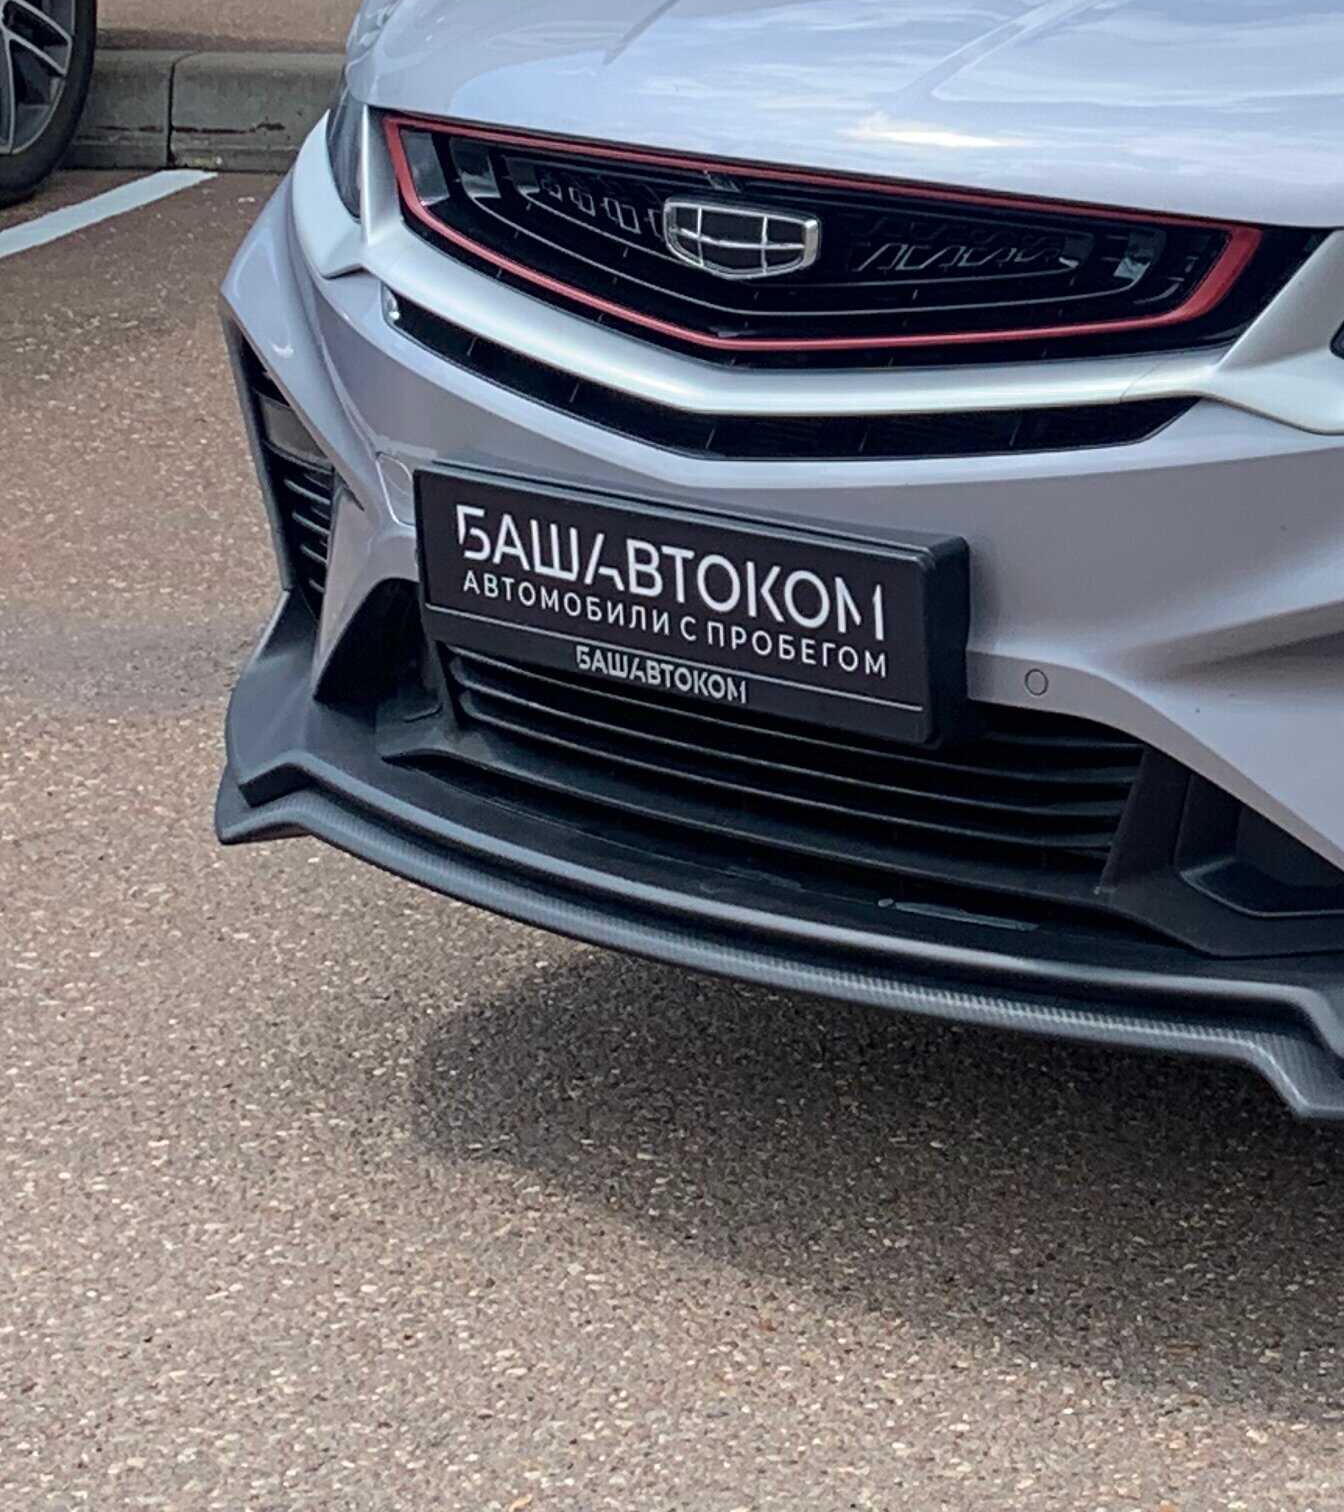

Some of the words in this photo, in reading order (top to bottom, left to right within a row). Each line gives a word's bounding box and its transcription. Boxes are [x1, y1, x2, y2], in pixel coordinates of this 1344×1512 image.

[455, 504, 885, 641] БАШАВТОКОМ
[463, 569, 672, 636] АВТОМОБИЛИ
[680, 615, 698, 642] С
[707, 621, 888, 678] ПРОБЕГОМ
[575, 645, 748, 705] БАШАВТОКОМ
